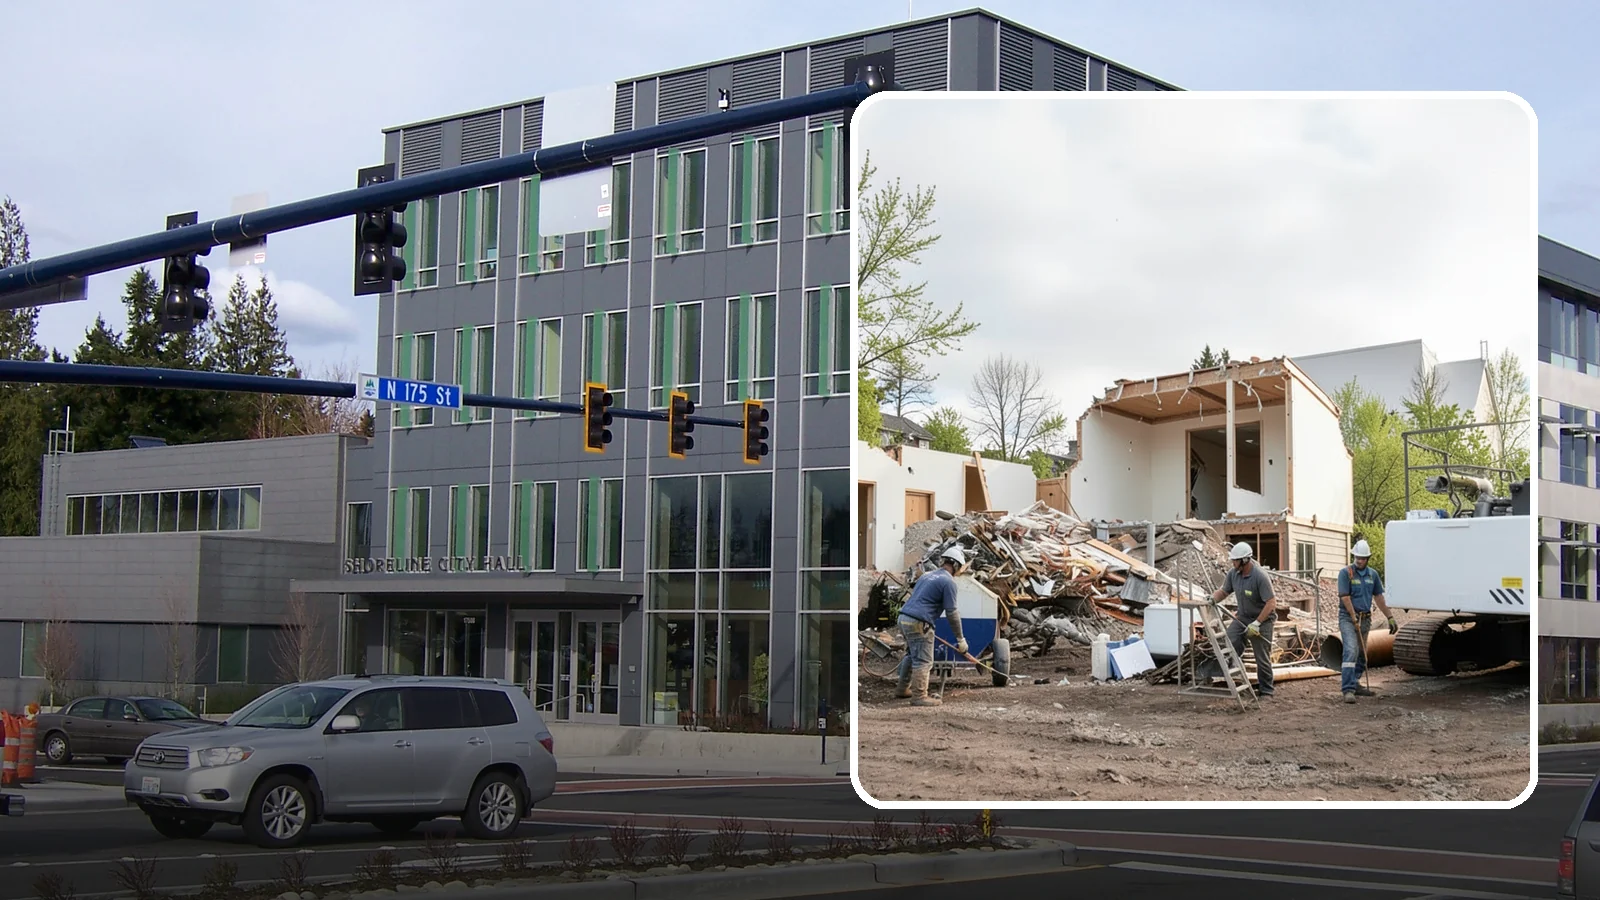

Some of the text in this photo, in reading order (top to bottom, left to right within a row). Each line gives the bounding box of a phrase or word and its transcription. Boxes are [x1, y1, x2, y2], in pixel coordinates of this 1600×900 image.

[387, 381, 451, 406] N 175 St
[344, 556, 525, 574] SHORELINE CITY HALL
